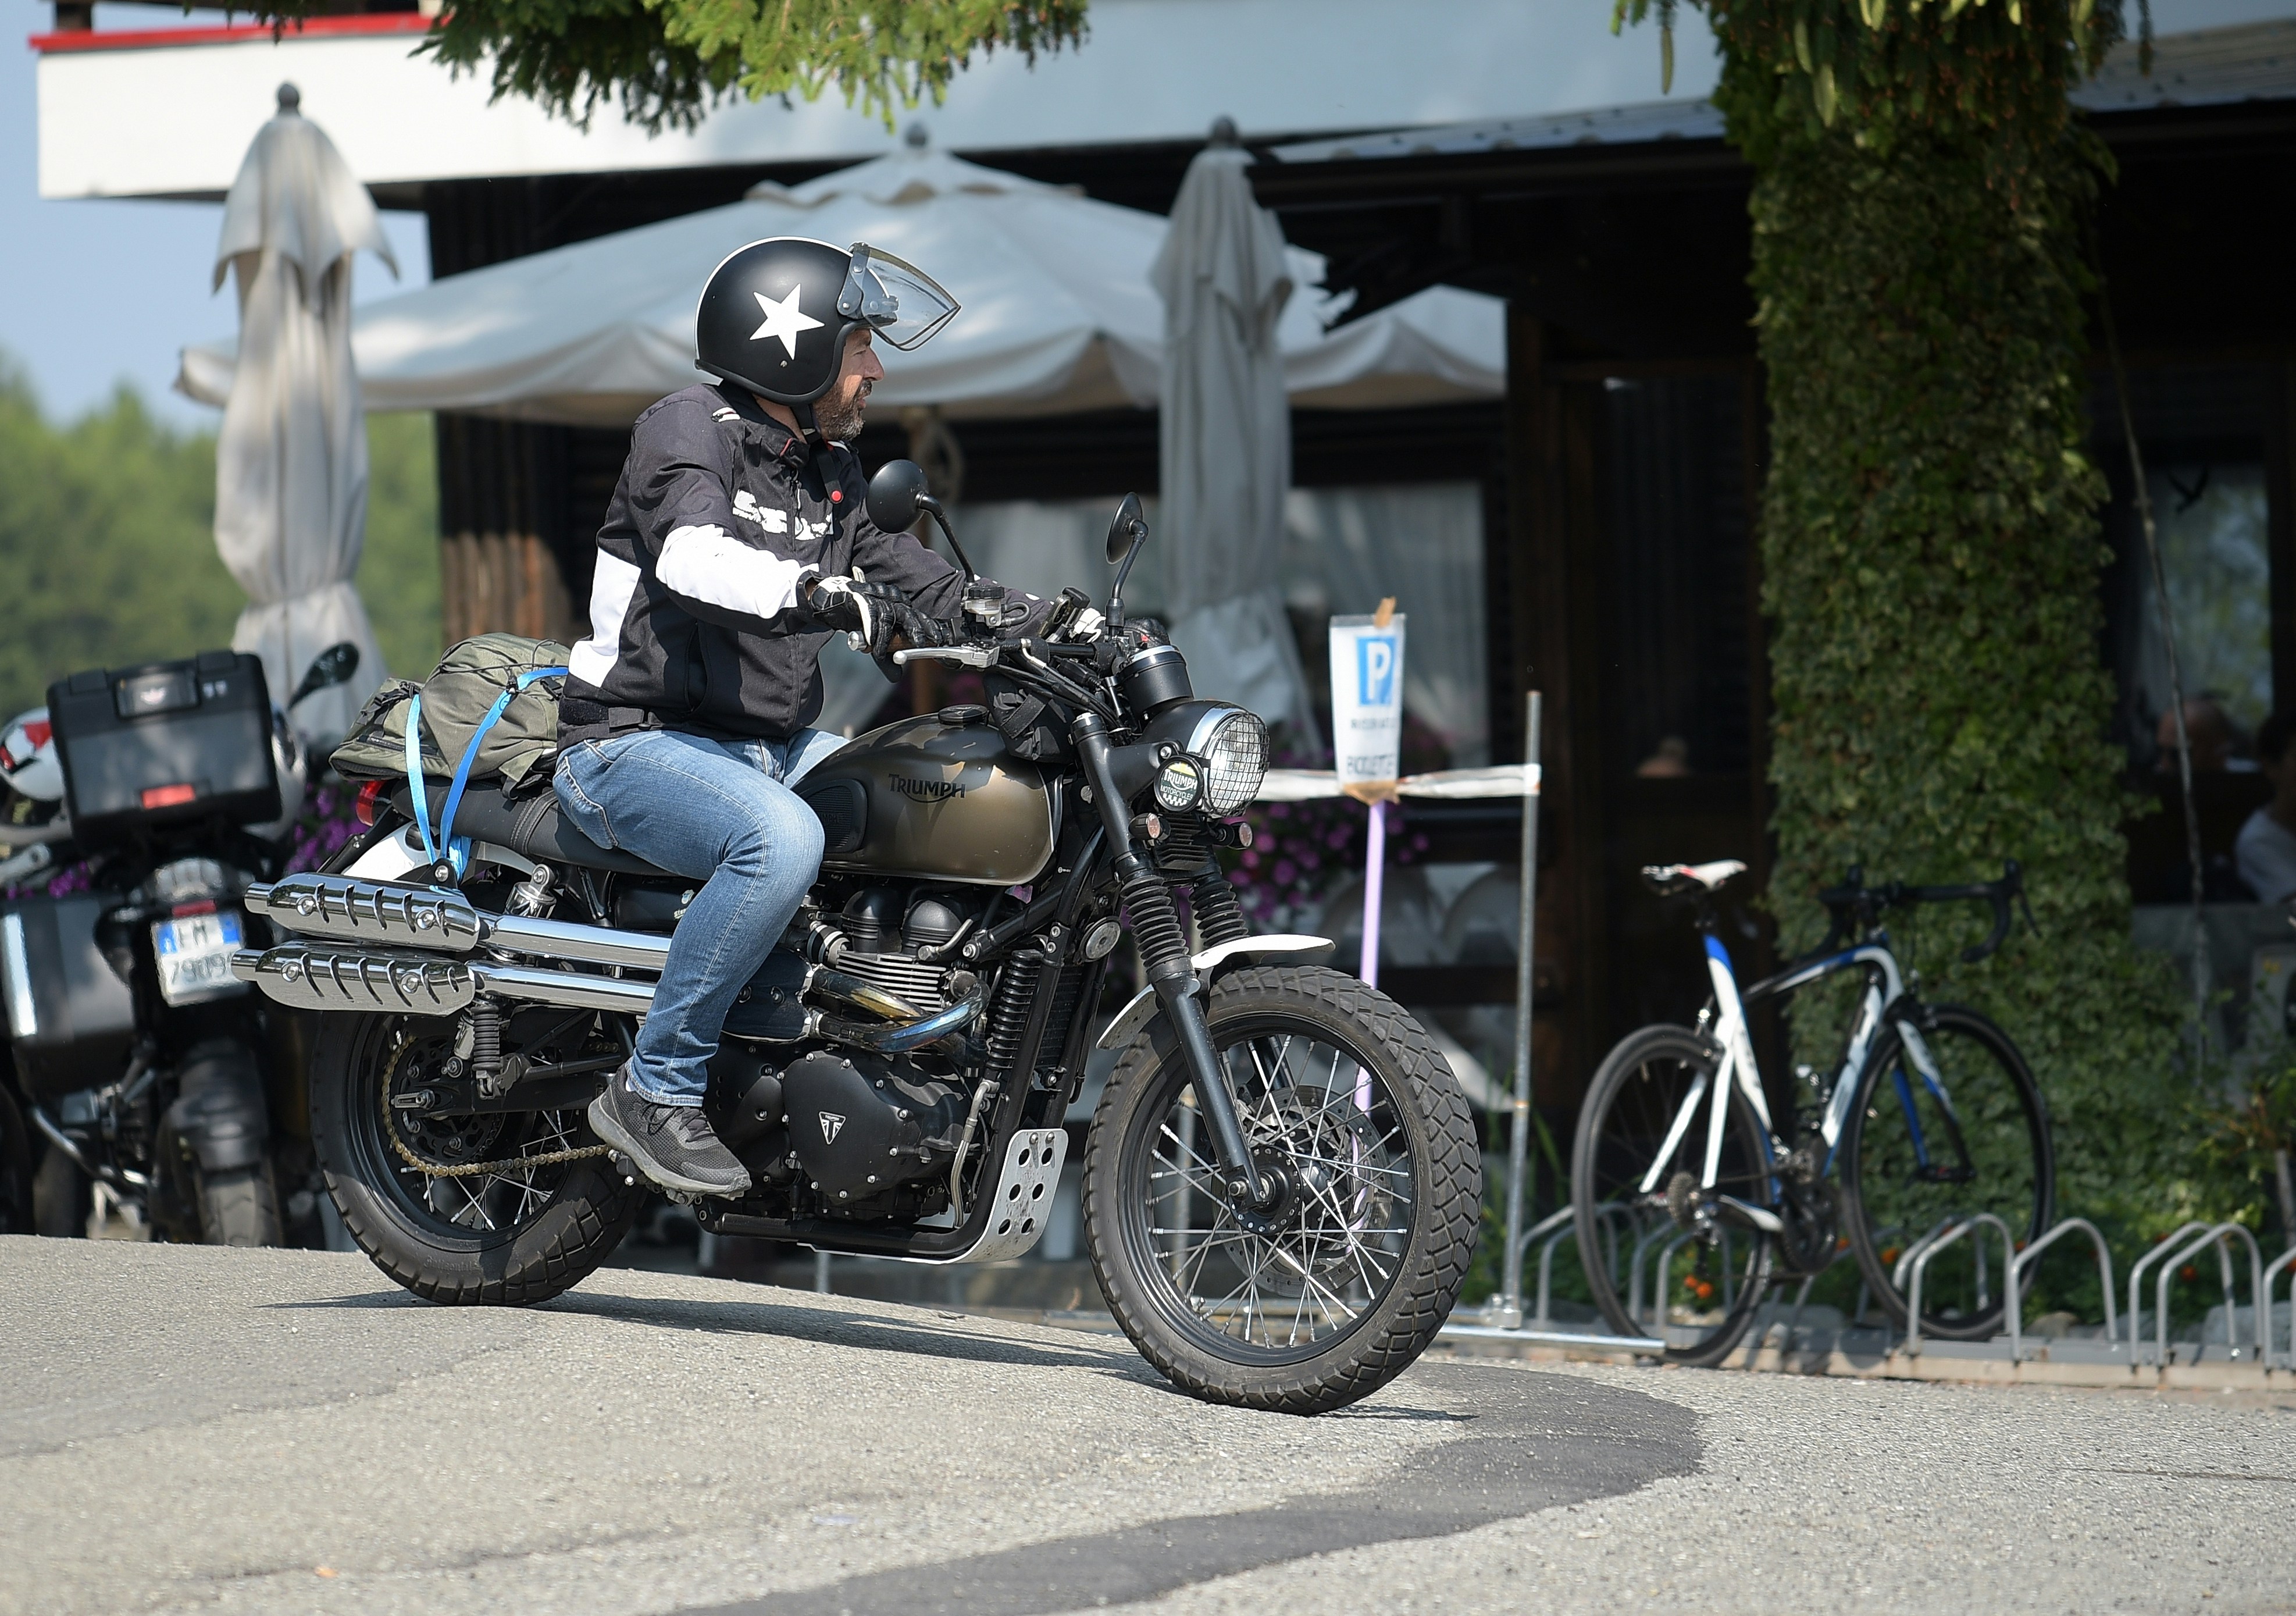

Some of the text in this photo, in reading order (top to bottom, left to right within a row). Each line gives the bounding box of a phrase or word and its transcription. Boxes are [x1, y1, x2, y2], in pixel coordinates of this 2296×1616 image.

[1367, 642, 1392, 700] P
[889, 773, 966, 803] TRIUMPH
[1164, 768, 1198, 790] TRIUMPH
[1160, 785, 1193, 801] MOTORCYCLES
